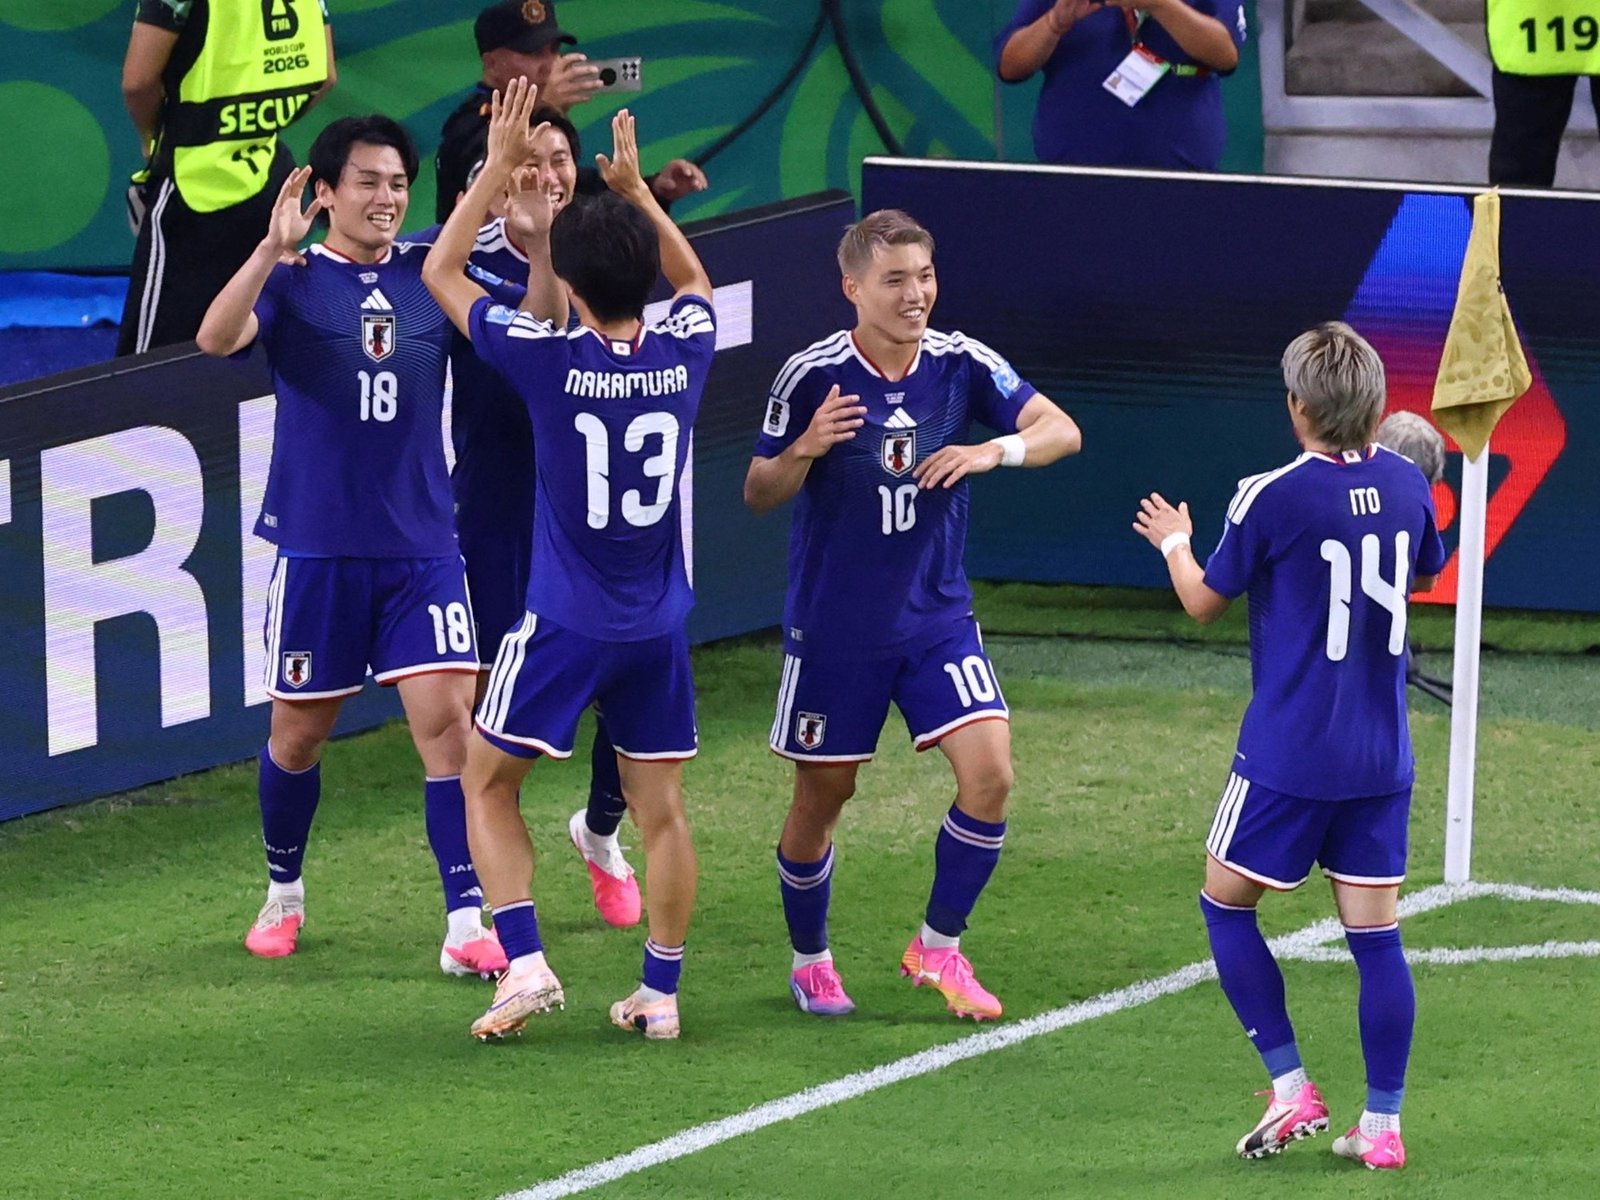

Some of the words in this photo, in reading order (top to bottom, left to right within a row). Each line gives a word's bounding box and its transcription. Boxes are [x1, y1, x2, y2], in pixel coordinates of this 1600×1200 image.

[263, 44, 289, 56] WORLD
[290, 42, 305, 52] CUP
[1519, 14, 1599, 53] 119
[263, 53, 310, 74] 2026
[357, 370, 398, 422] 18
[564, 364, 688, 399] NAKAMURA
[574, 411, 680, 530] 13
[878, 483, 919, 536] 10
[1349, 487, 1381, 516] ITO
[1320, 530, 1410, 662] 14
[427, 601, 471, 655] 18
[943, 655, 996, 708] 10
